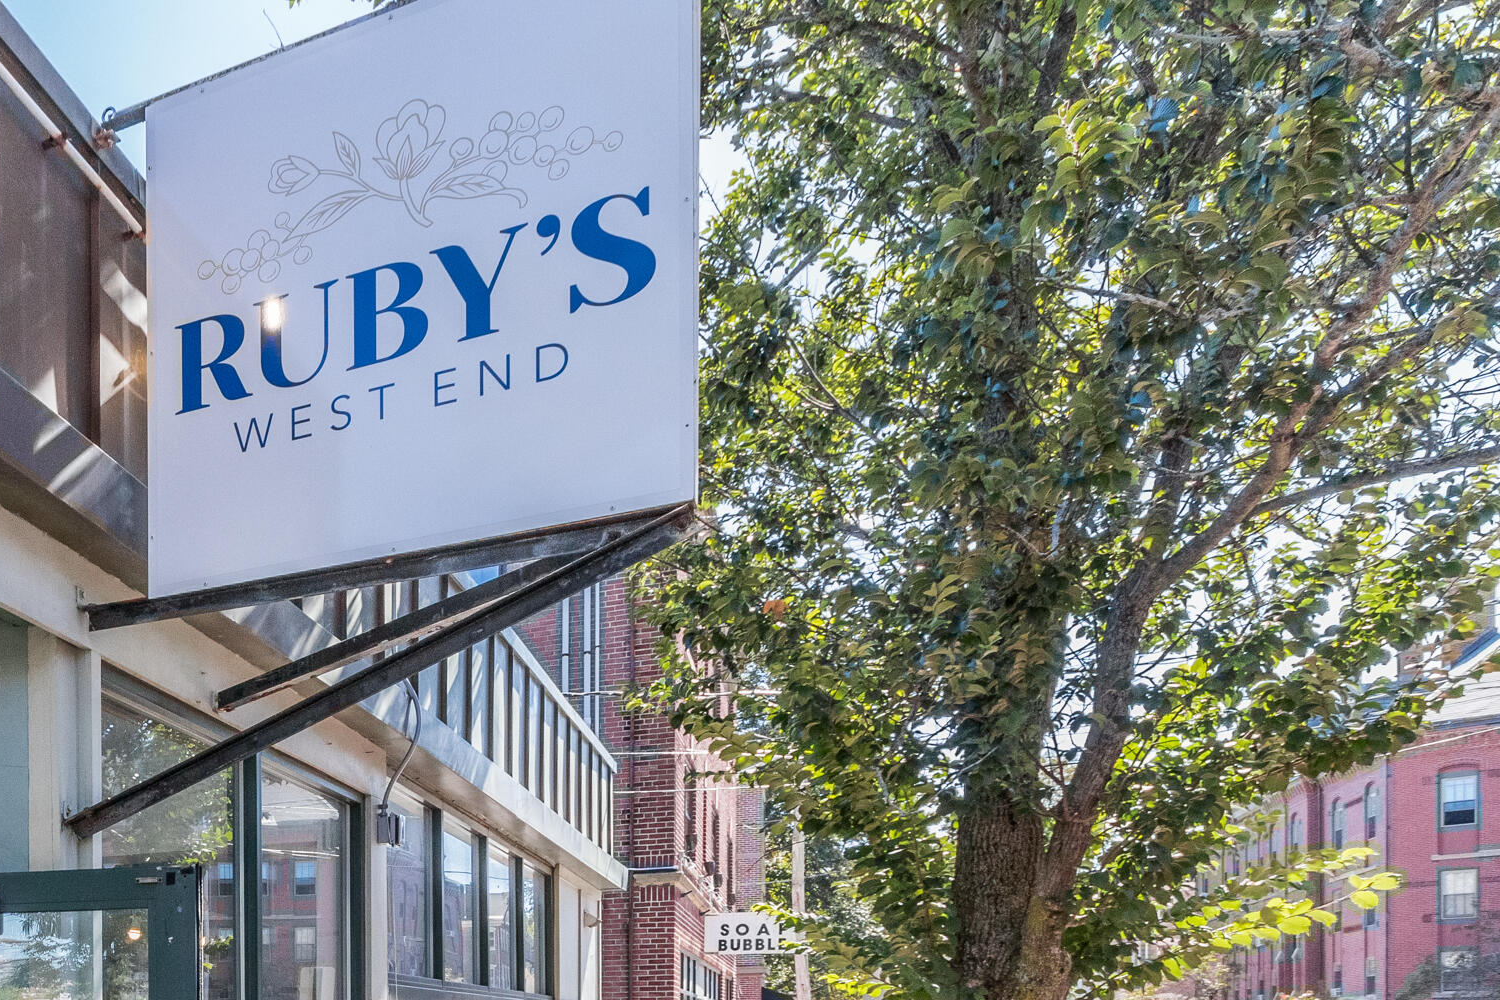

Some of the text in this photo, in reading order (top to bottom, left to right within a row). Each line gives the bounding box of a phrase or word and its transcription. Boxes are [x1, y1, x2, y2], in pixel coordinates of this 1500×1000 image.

[175, 186, 656, 416] RUBY'S
[233, 343, 569, 453] WEST END
